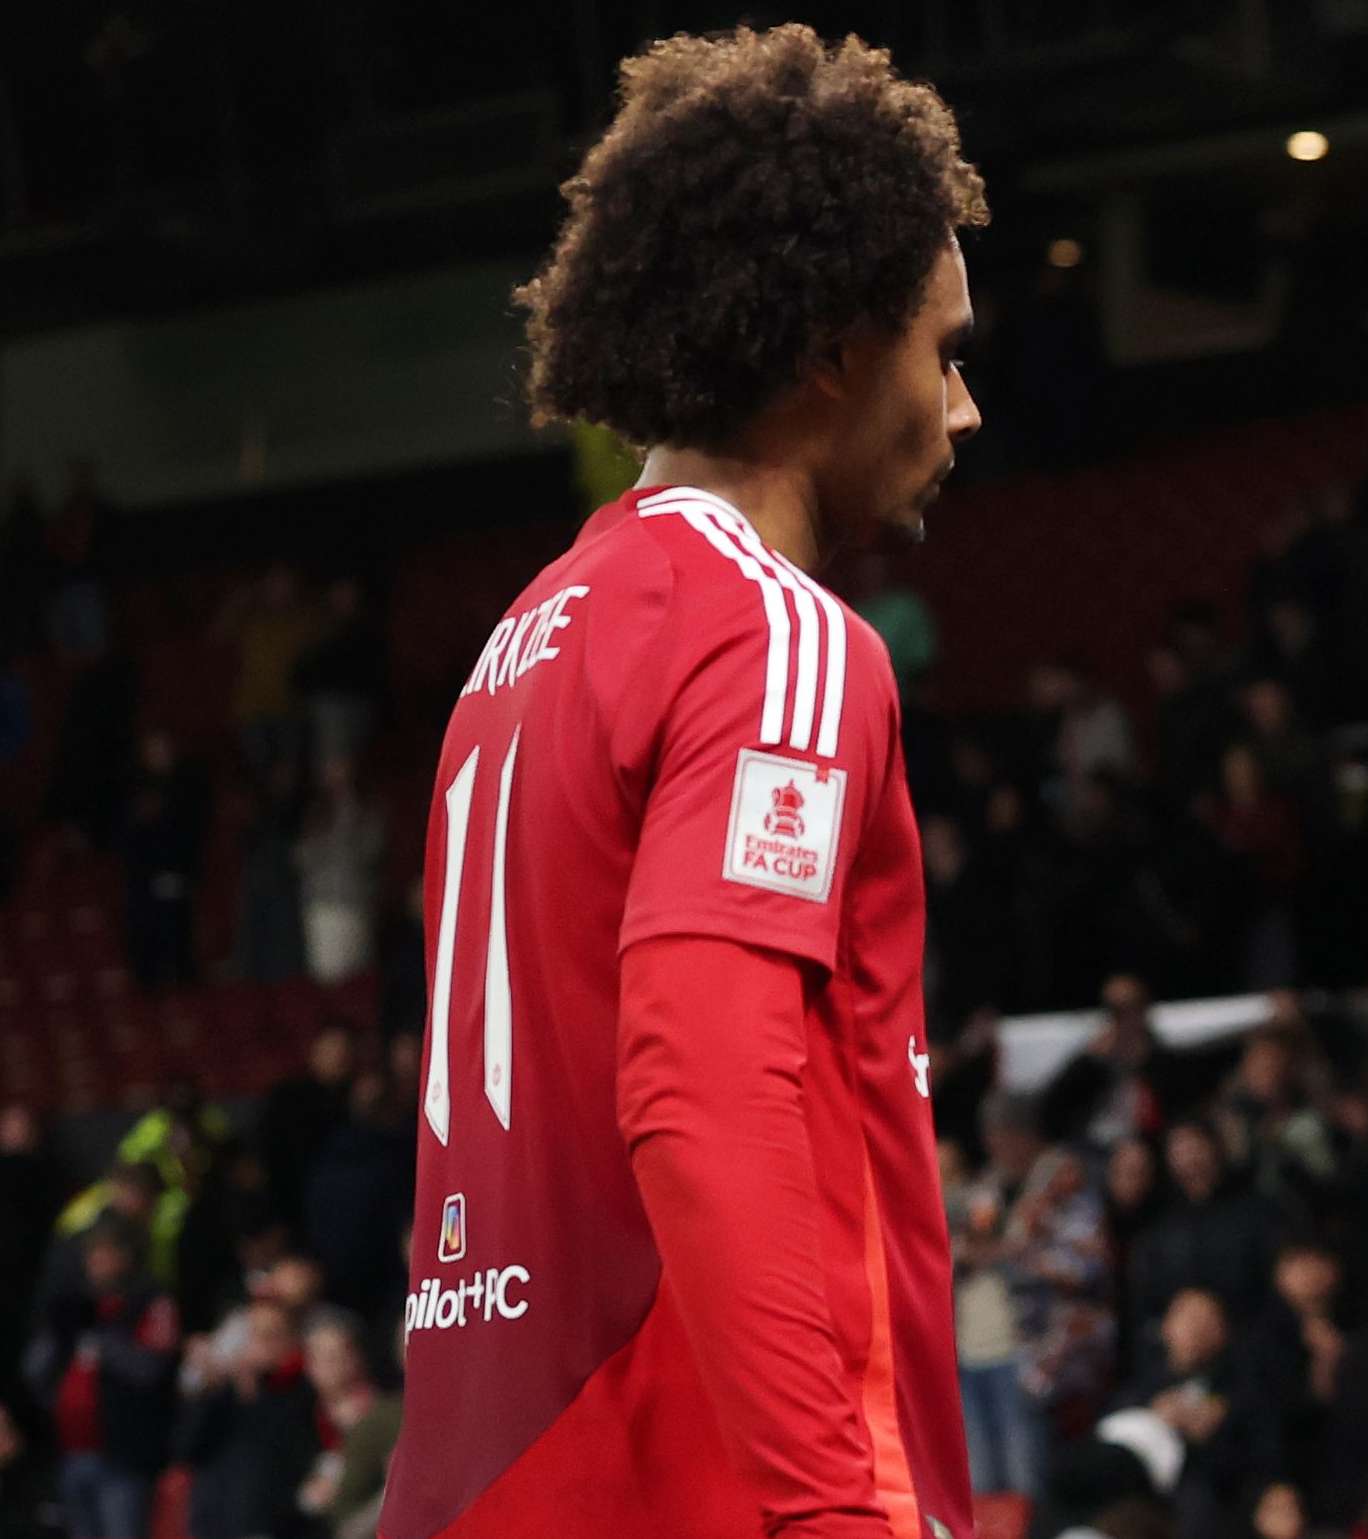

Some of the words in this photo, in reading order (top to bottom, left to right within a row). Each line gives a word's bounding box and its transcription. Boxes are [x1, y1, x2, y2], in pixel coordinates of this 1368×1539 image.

[744, 833, 819, 864] Emirates
[743, 851, 769, 873] FA
[773, 857, 818, 881] CUP
[423, 720, 521, 1147] 11
